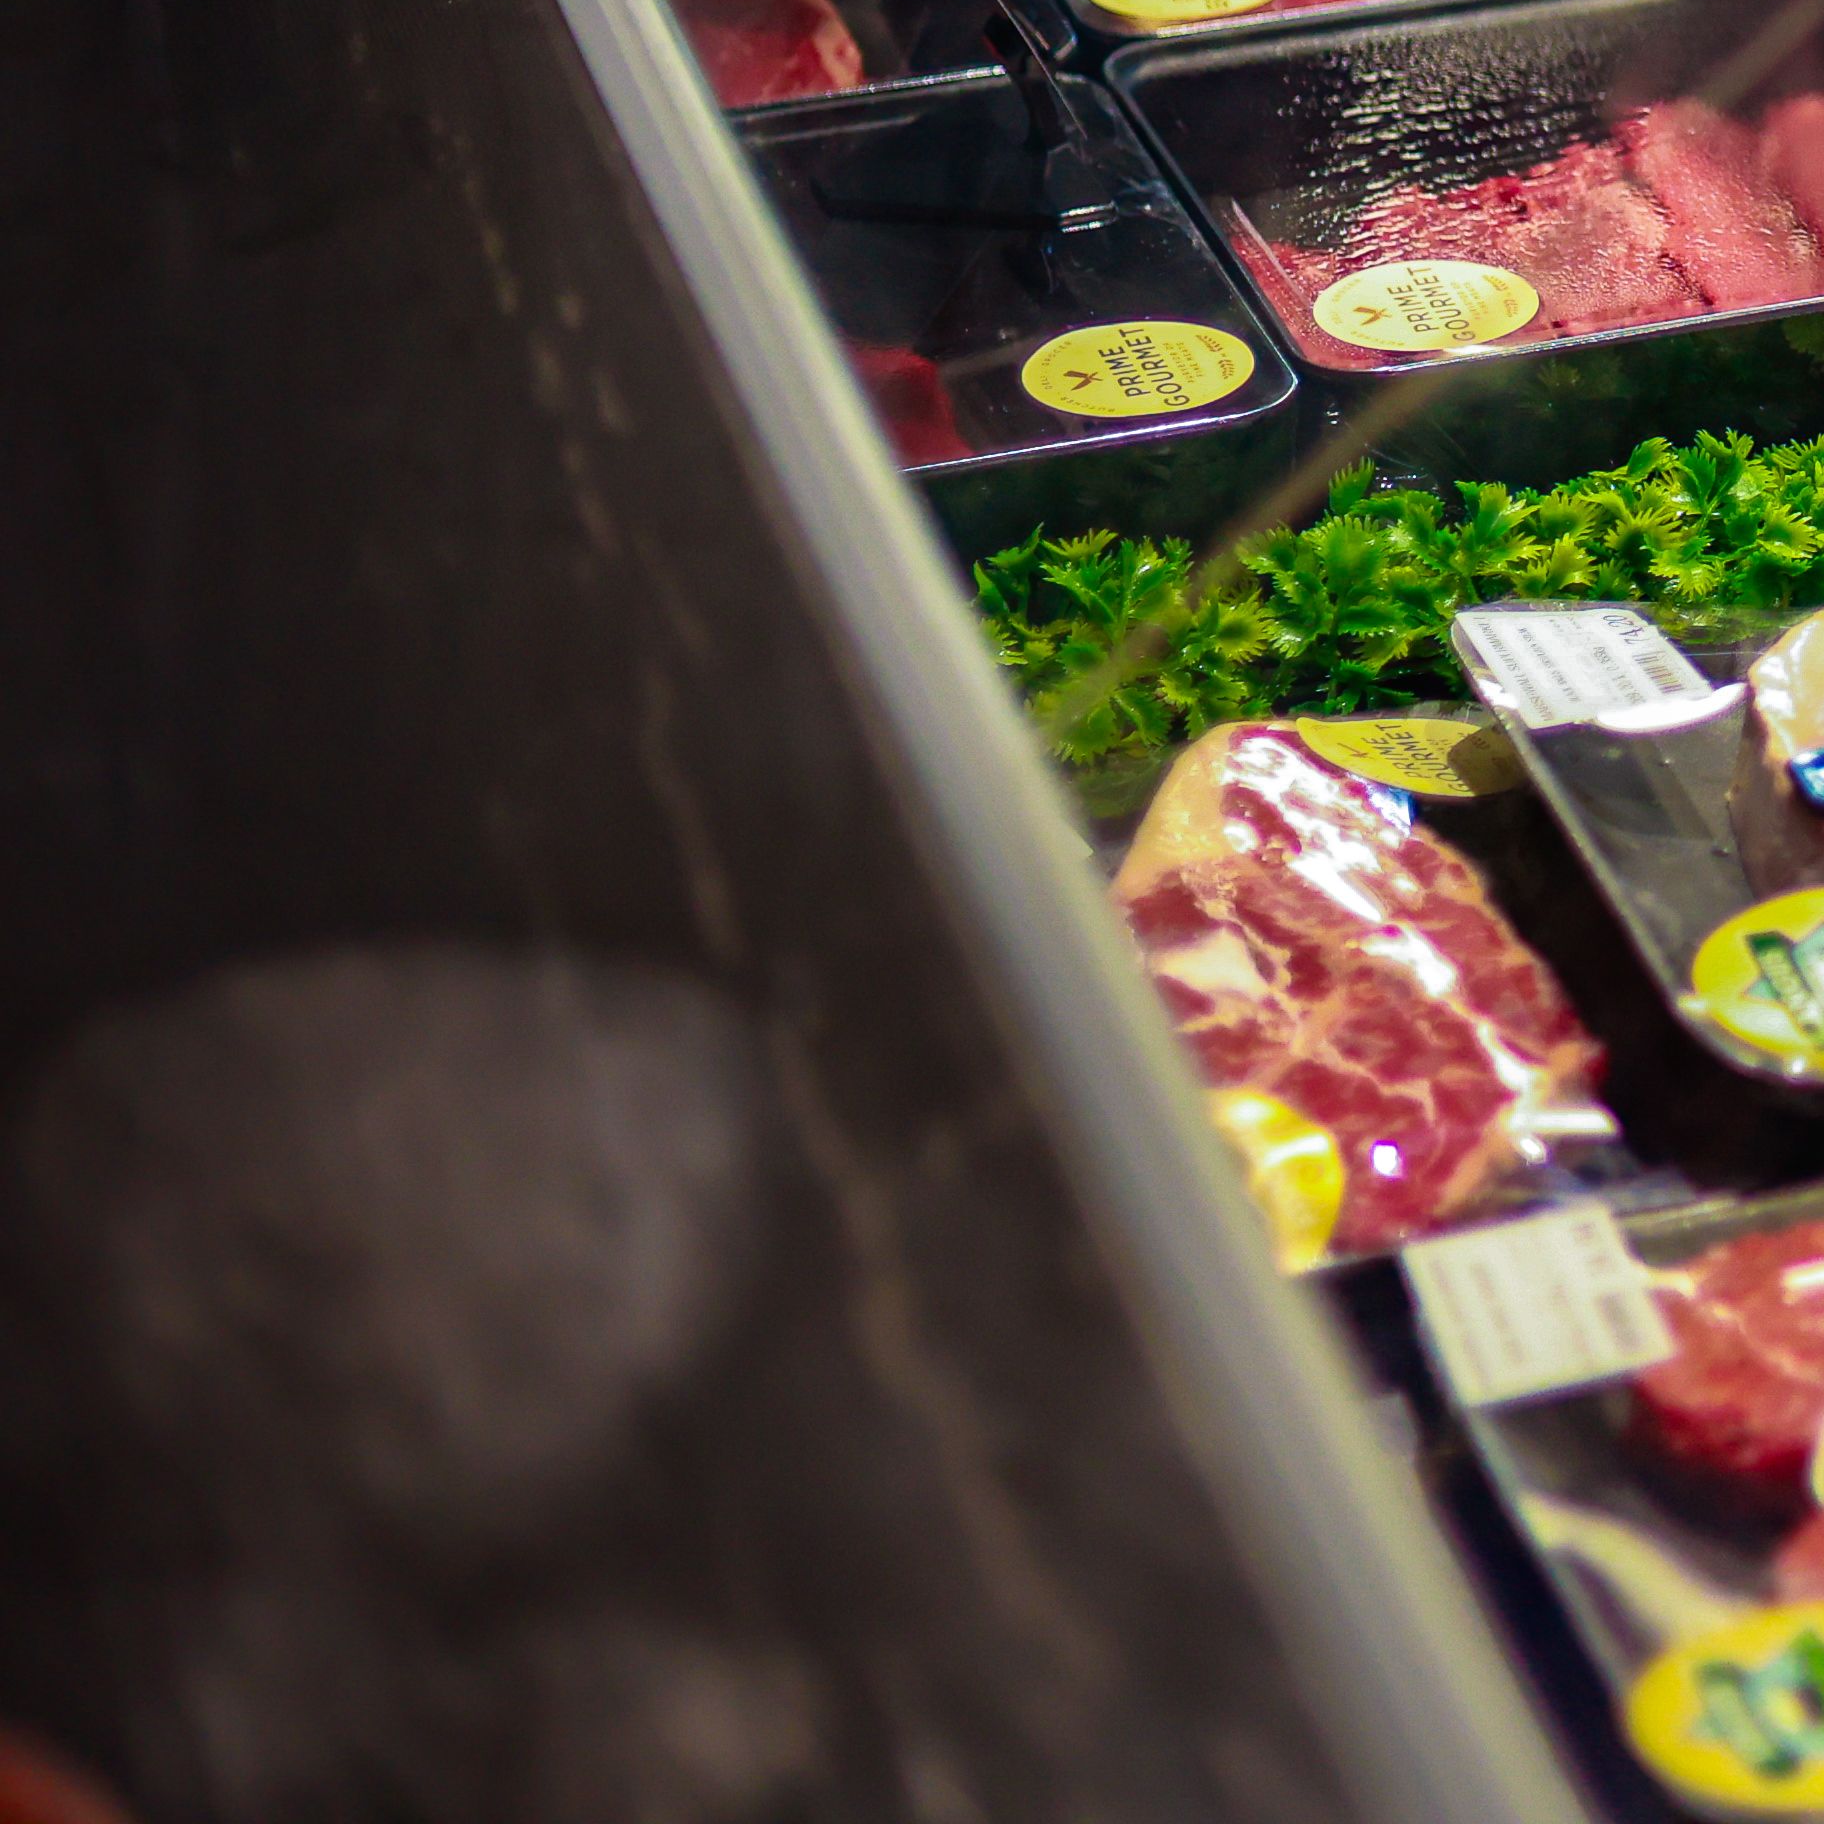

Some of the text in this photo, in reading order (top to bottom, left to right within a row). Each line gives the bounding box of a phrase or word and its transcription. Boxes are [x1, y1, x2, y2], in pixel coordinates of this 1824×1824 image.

[1387, 283, 1440, 333] PRIME
[1406, 266, 1477, 342] GOURMET
[1099, 345, 1151, 398] PRIME
[1120, 328, 1191, 407] GOURMET
[1362, 737, 1430, 779] PRIME
[1374, 723, 1471, 793] GOURMET
